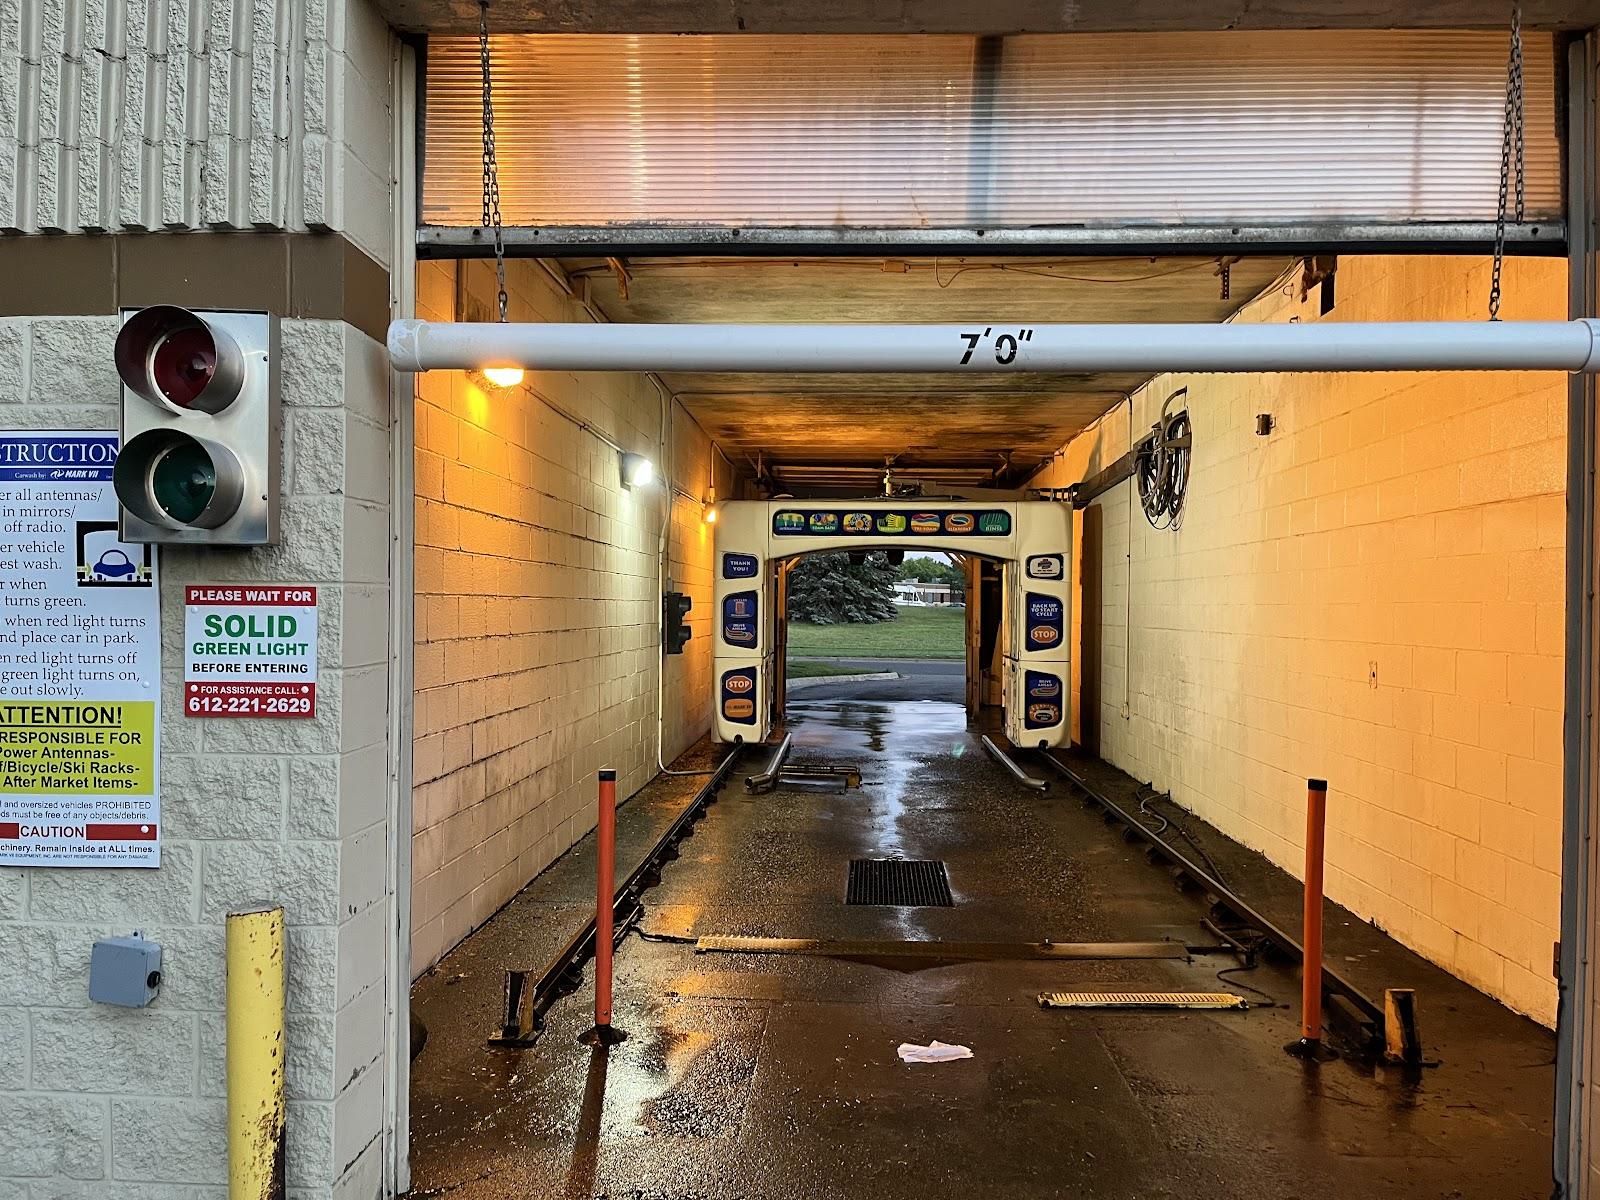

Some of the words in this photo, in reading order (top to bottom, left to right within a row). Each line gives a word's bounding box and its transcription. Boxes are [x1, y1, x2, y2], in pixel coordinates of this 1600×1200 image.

[0, 444, 118, 462] TRUCTION
[65, 470, 88, 478] MARK
[88, 470, 99, 478] VII
[16, 489, 31, 500] all
[36, 488, 102, 502] antennas/
[3, 506, 14, 517] in
[20, 505, 75, 518] mirrors/
[4, 520, 22, 532] off
[27, 520, 65, 532] radio.
[0, 544, 13, 552] er
[17, 541, 65, 552] vehicle
[0, 559, 19, 569] est
[23, 558, 61, 569] wash.
[10, 578, 46, 589] when
[191, 590, 242, 601] PLEASE
[246, 591, 280, 601] WAIT
[284, 591, 311, 602] FOR
[5, 596, 40, 606] turns
[44, 597, 86, 610] green.
[5, 615, 41, 627] when
[47, 615, 68, 627] red
[73, 615, 105, 630] light
[109, 616, 146, 627] turns
[205, 614, 297, 638] SOLID
[22, 631, 56, 647] place
[61, 634, 81, 643] car
[86, 632, 98, 643] in
[104, 632, 139, 647] park.
[193, 642, 250, 655] GREEN
[257, 643, 308, 655] LIGHT
[16, 652, 36, 663] red
[42, 652, 73, 667] light
[78, 653, 113, 664] turns
[118, 652, 137, 664] off
[193, 663, 241, 672] BEFORE
[246, 664, 308, 673] ENTERING
[2, 670, 38, 683] green
[43, 668, 74, 684] light
[80, 670, 114, 680] turns
[119, 672, 140, 682] on,
[11, 685, 32, 695] out
[37, 683, 83, 699] slowly.
[189, 697, 310, 712] 612-221-2629
[0, 732, 104, 744] RESPONSIBLE
[110, 733, 141, 744] FOR
[41, 747, 115, 758] Antennas-
[90, 762, 140, 774] Racks-
[3, 776, 36, 787] After
[41, 776, 88, 788] Market
[94, 777, 138, 788] Items-
[90, 812, 148, 820] objects/debris.
[20, 826, 84, 838] CAUTION
